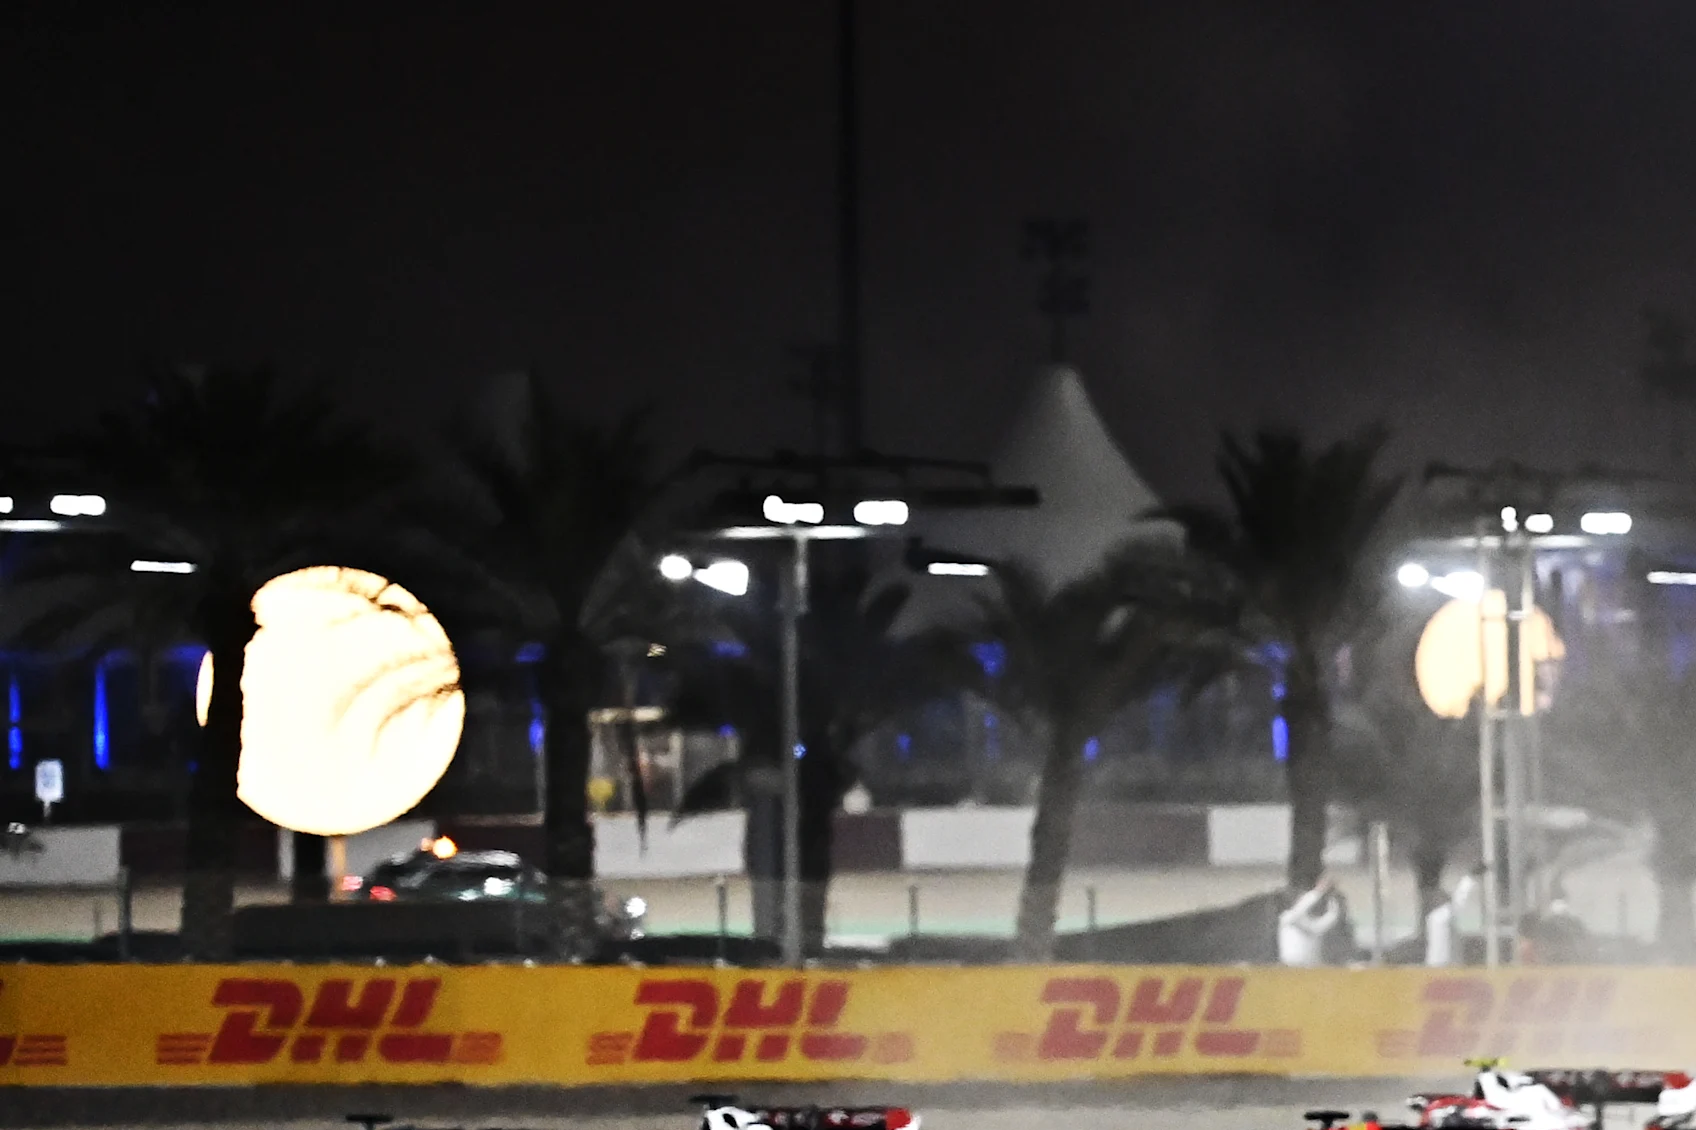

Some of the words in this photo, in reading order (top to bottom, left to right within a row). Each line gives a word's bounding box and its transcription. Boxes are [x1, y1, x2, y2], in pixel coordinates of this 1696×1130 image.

[206, 977, 453, 1064] DHL
[632, 979, 868, 1063] DHL
[1036, 976, 1260, 1061] DHL
[1416, 976, 1624, 1056] DHL
